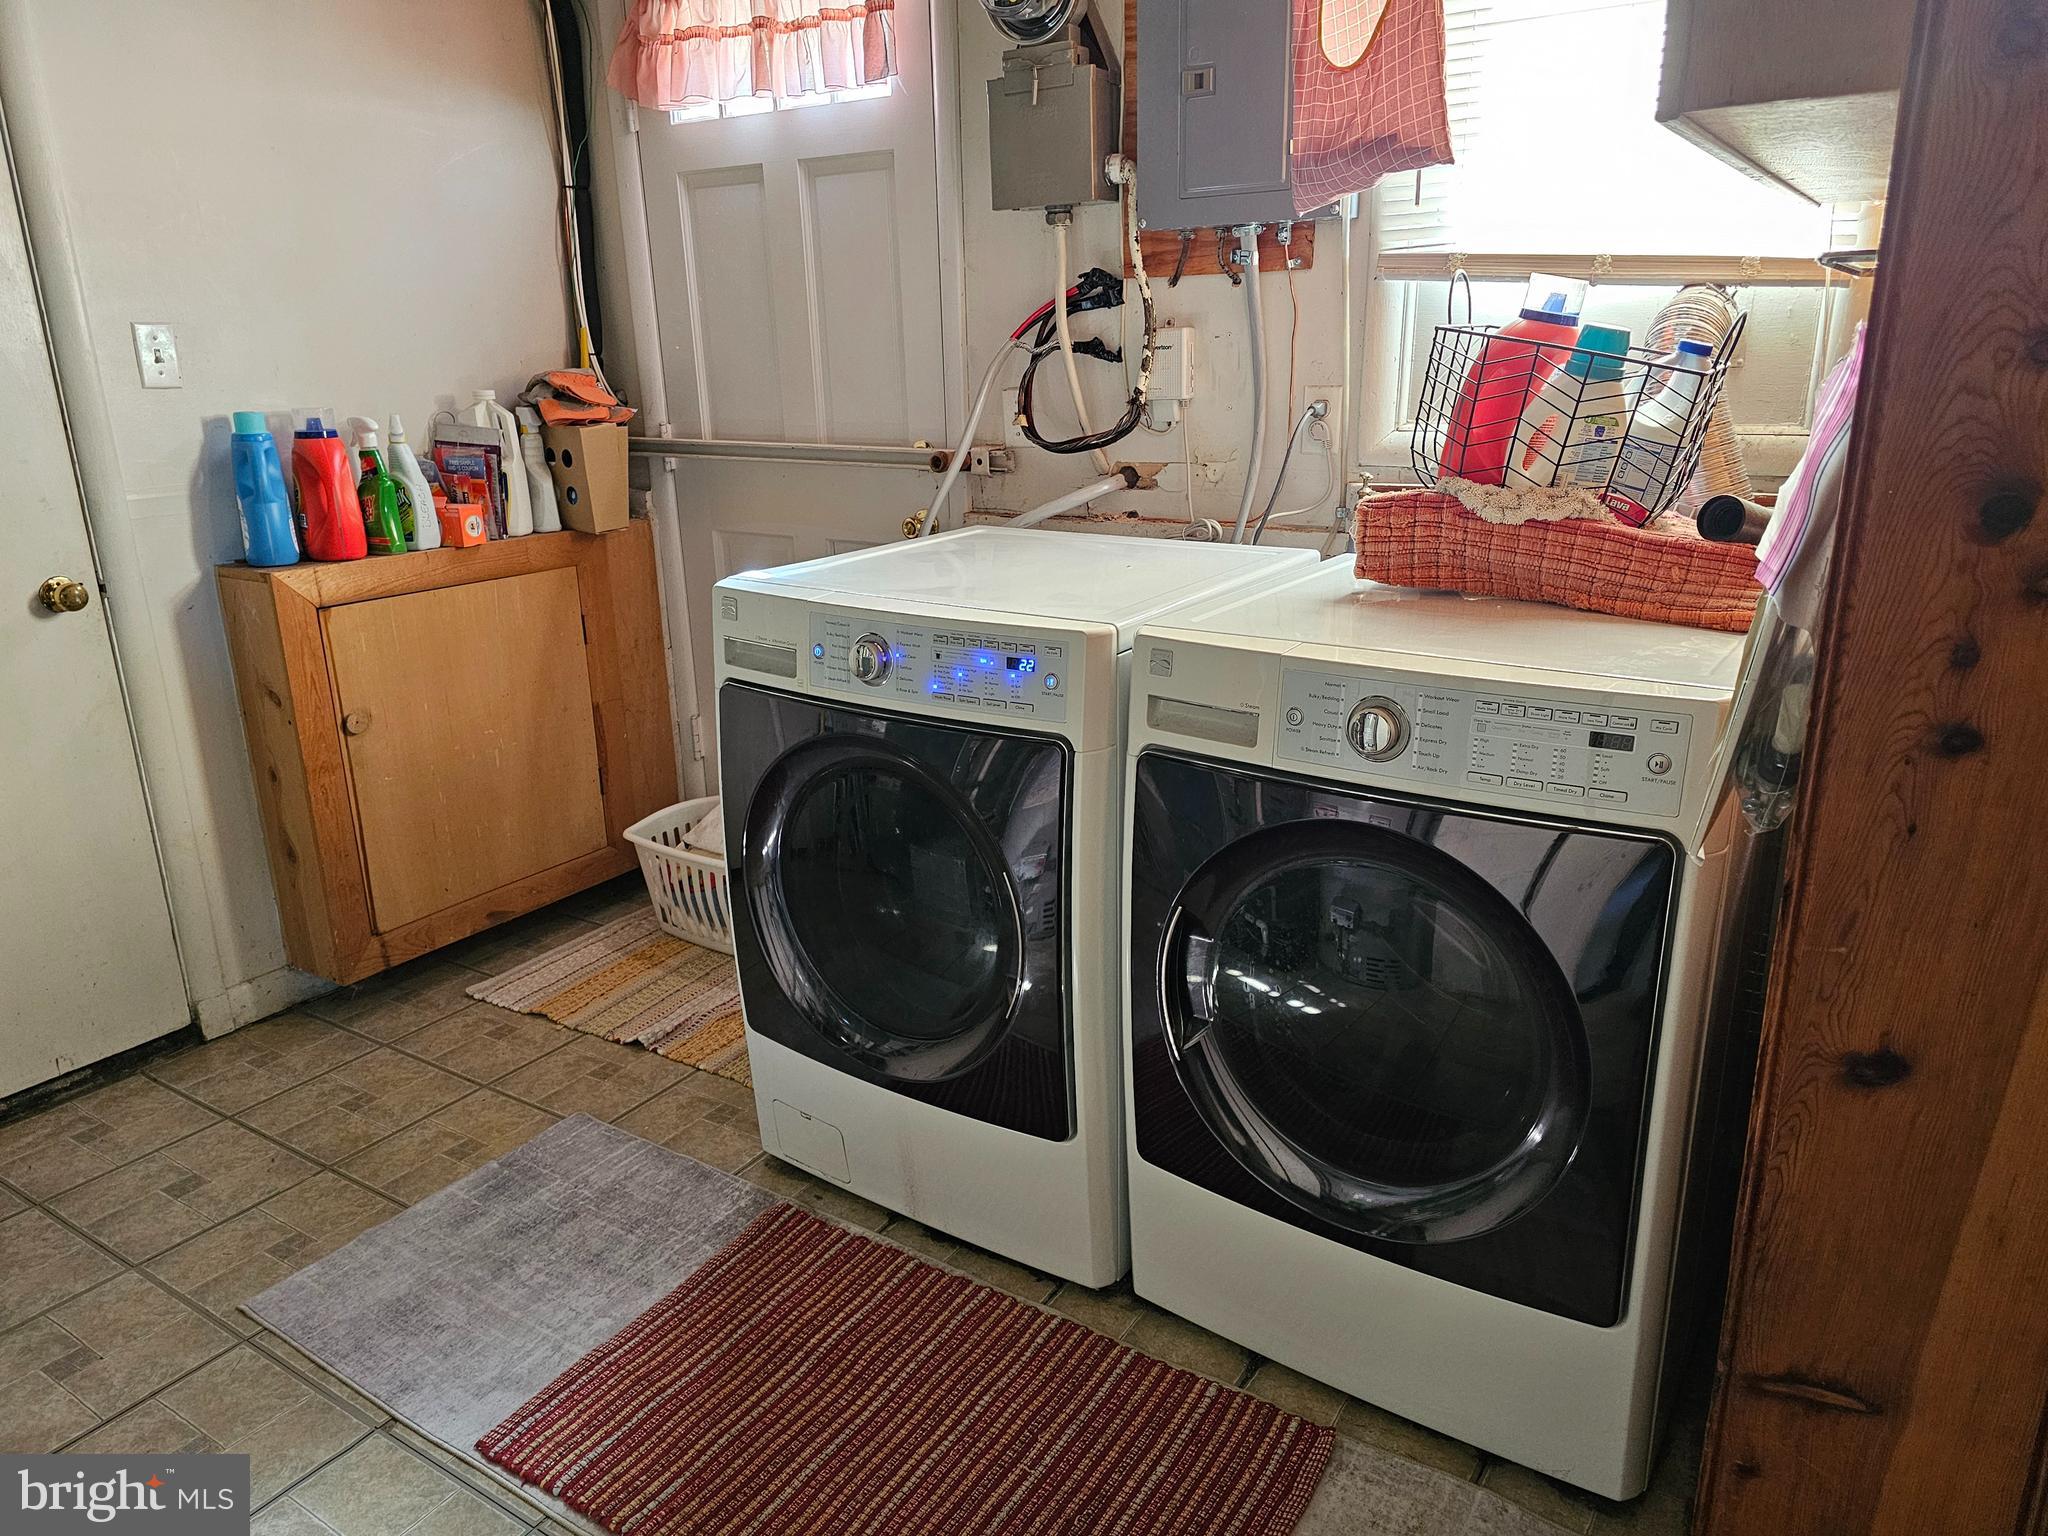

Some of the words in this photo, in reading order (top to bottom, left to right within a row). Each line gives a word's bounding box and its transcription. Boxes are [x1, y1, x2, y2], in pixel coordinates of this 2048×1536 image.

[1605, 496, 1630, 511] Lava
[1019, 659, 1035, 672] 22
[1424, 693, 1445, 701] Workout
[1245, 702, 1260, 710] Steam
[1436, 709, 1450, 717] Load
[1420, 722, 1443, 731] Delicates
[1419, 737, 1438, 745] Express
[1438, 767, 1448, 775] Dry
[1642, 776, 1677, 786] START/PAUSE
